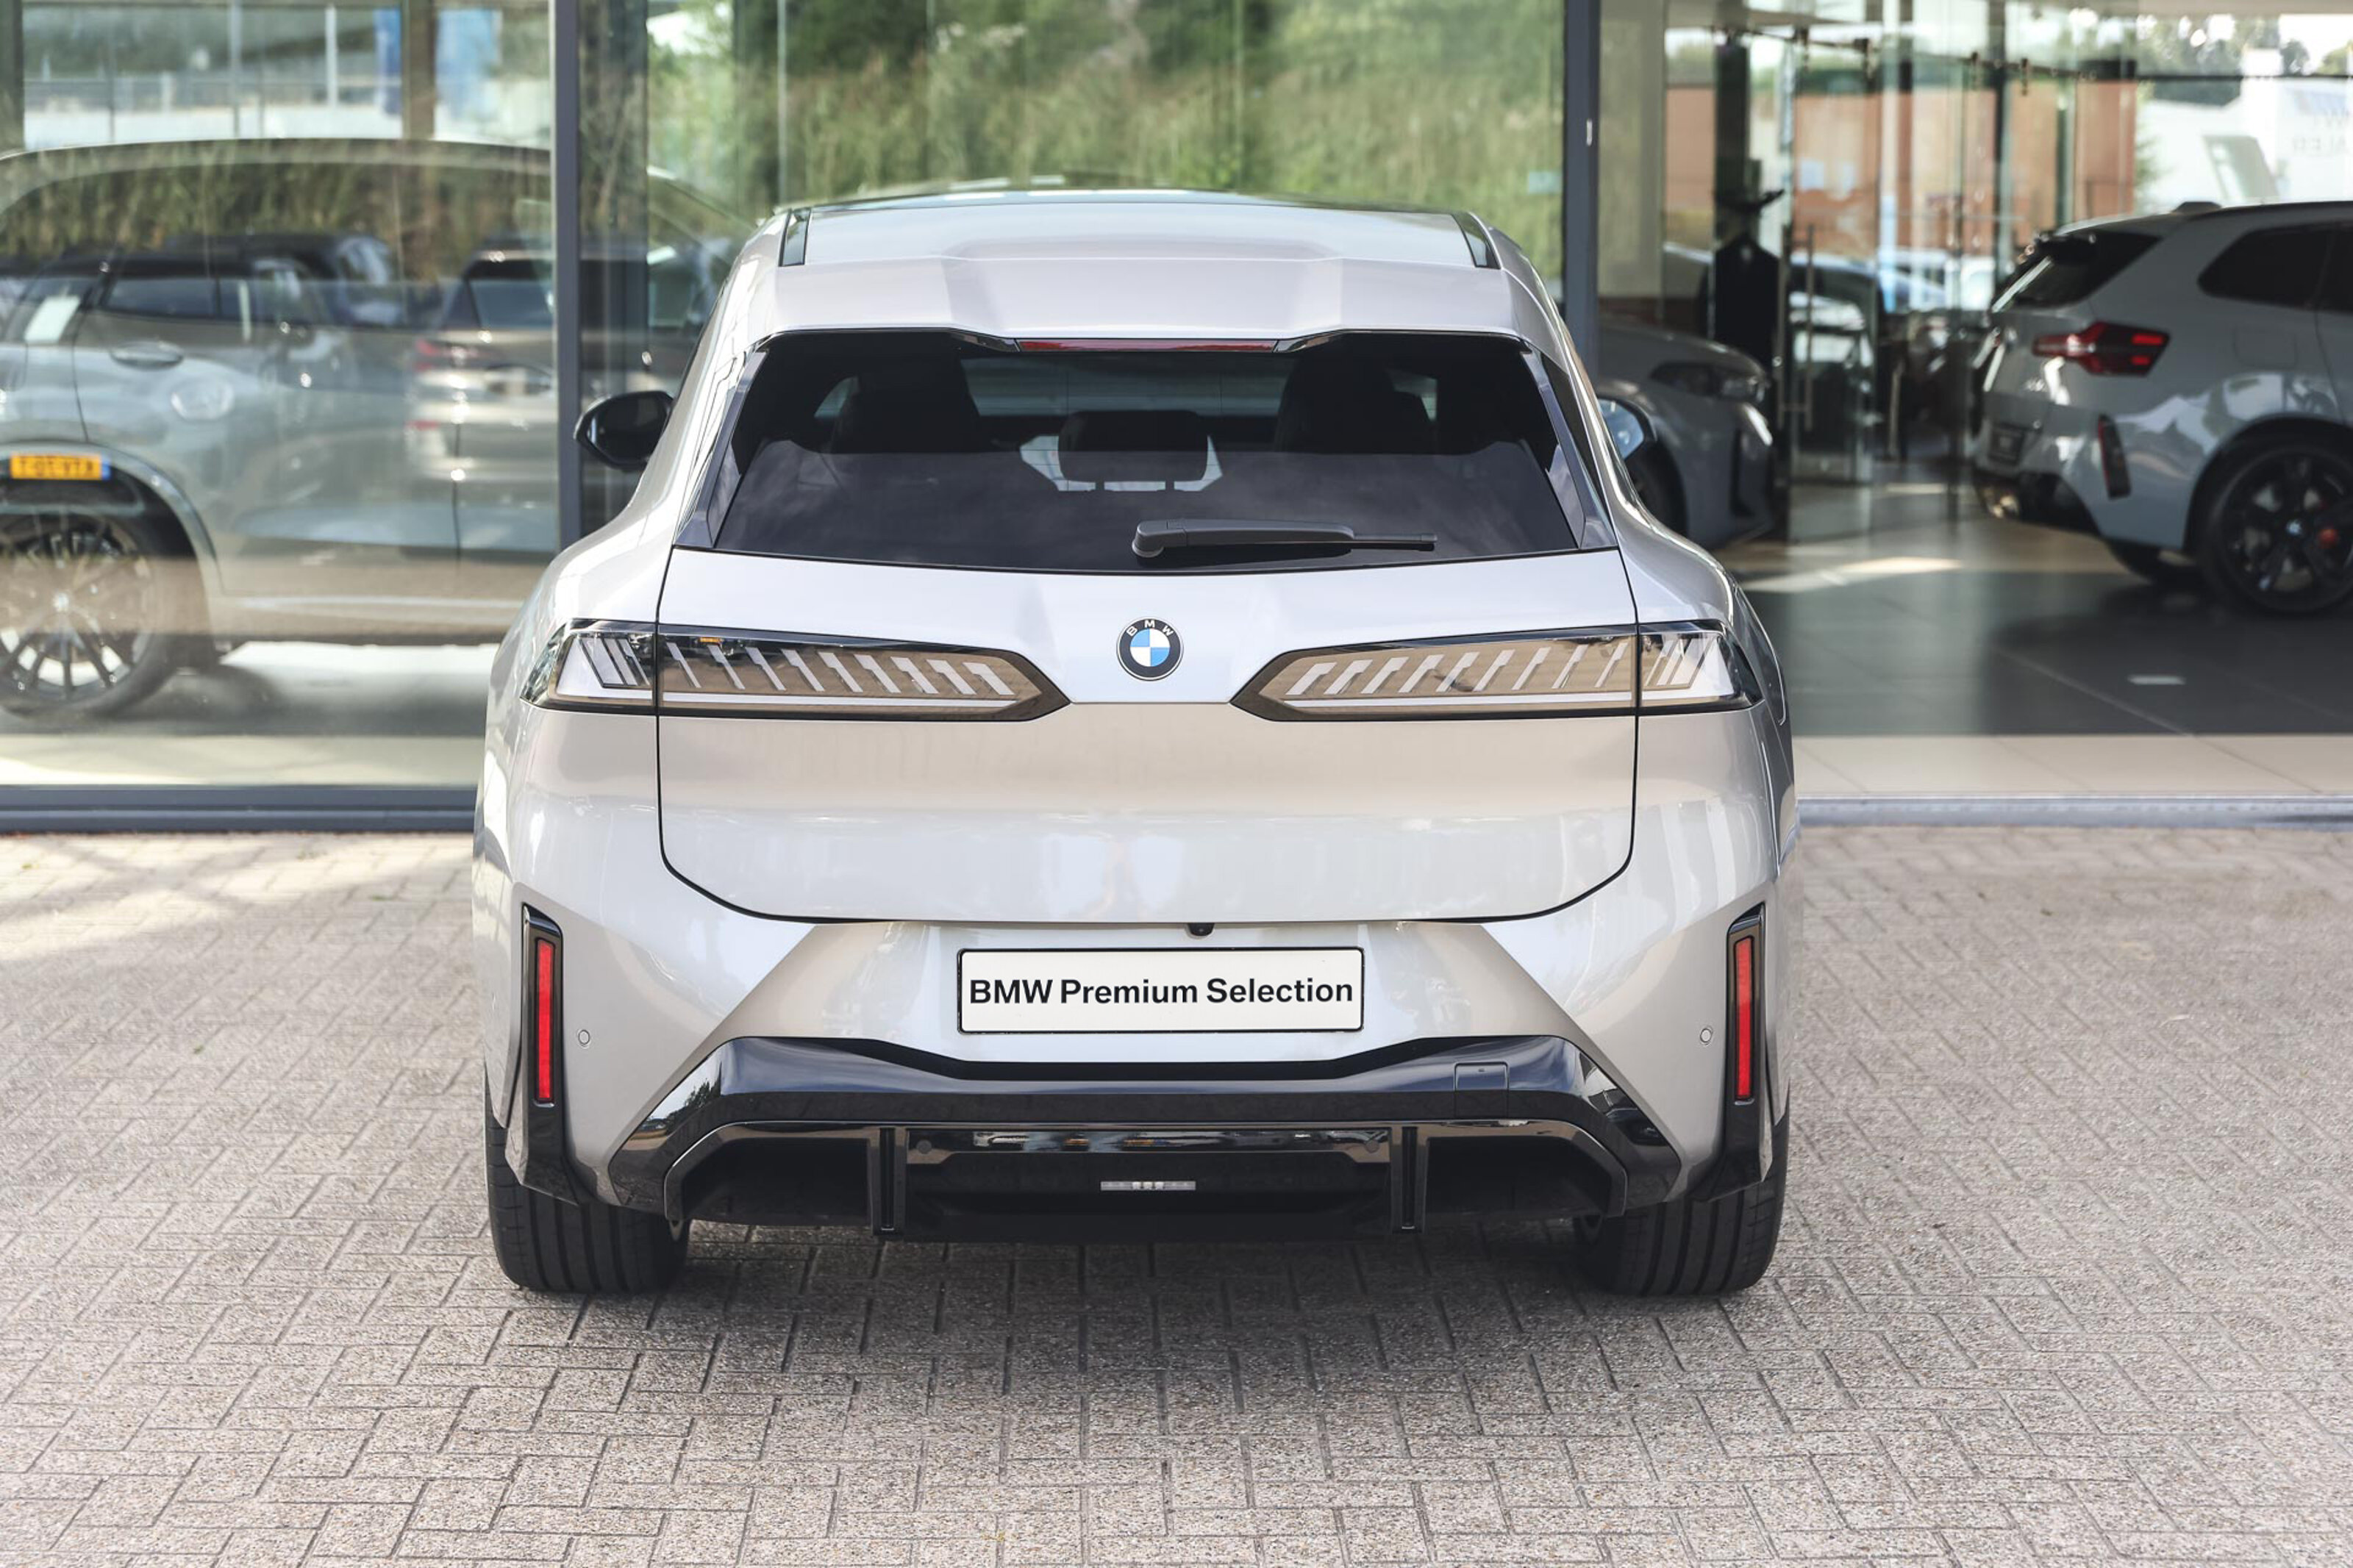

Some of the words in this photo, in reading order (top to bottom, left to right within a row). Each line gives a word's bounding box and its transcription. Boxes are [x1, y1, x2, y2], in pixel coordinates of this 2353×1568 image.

[1126, 620, 1174, 637] BMW
[969, 978, 1053, 1004] BMW
[1060, 978, 1198, 1004] Premium
[1206, 977, 1354, 1003] Selection
